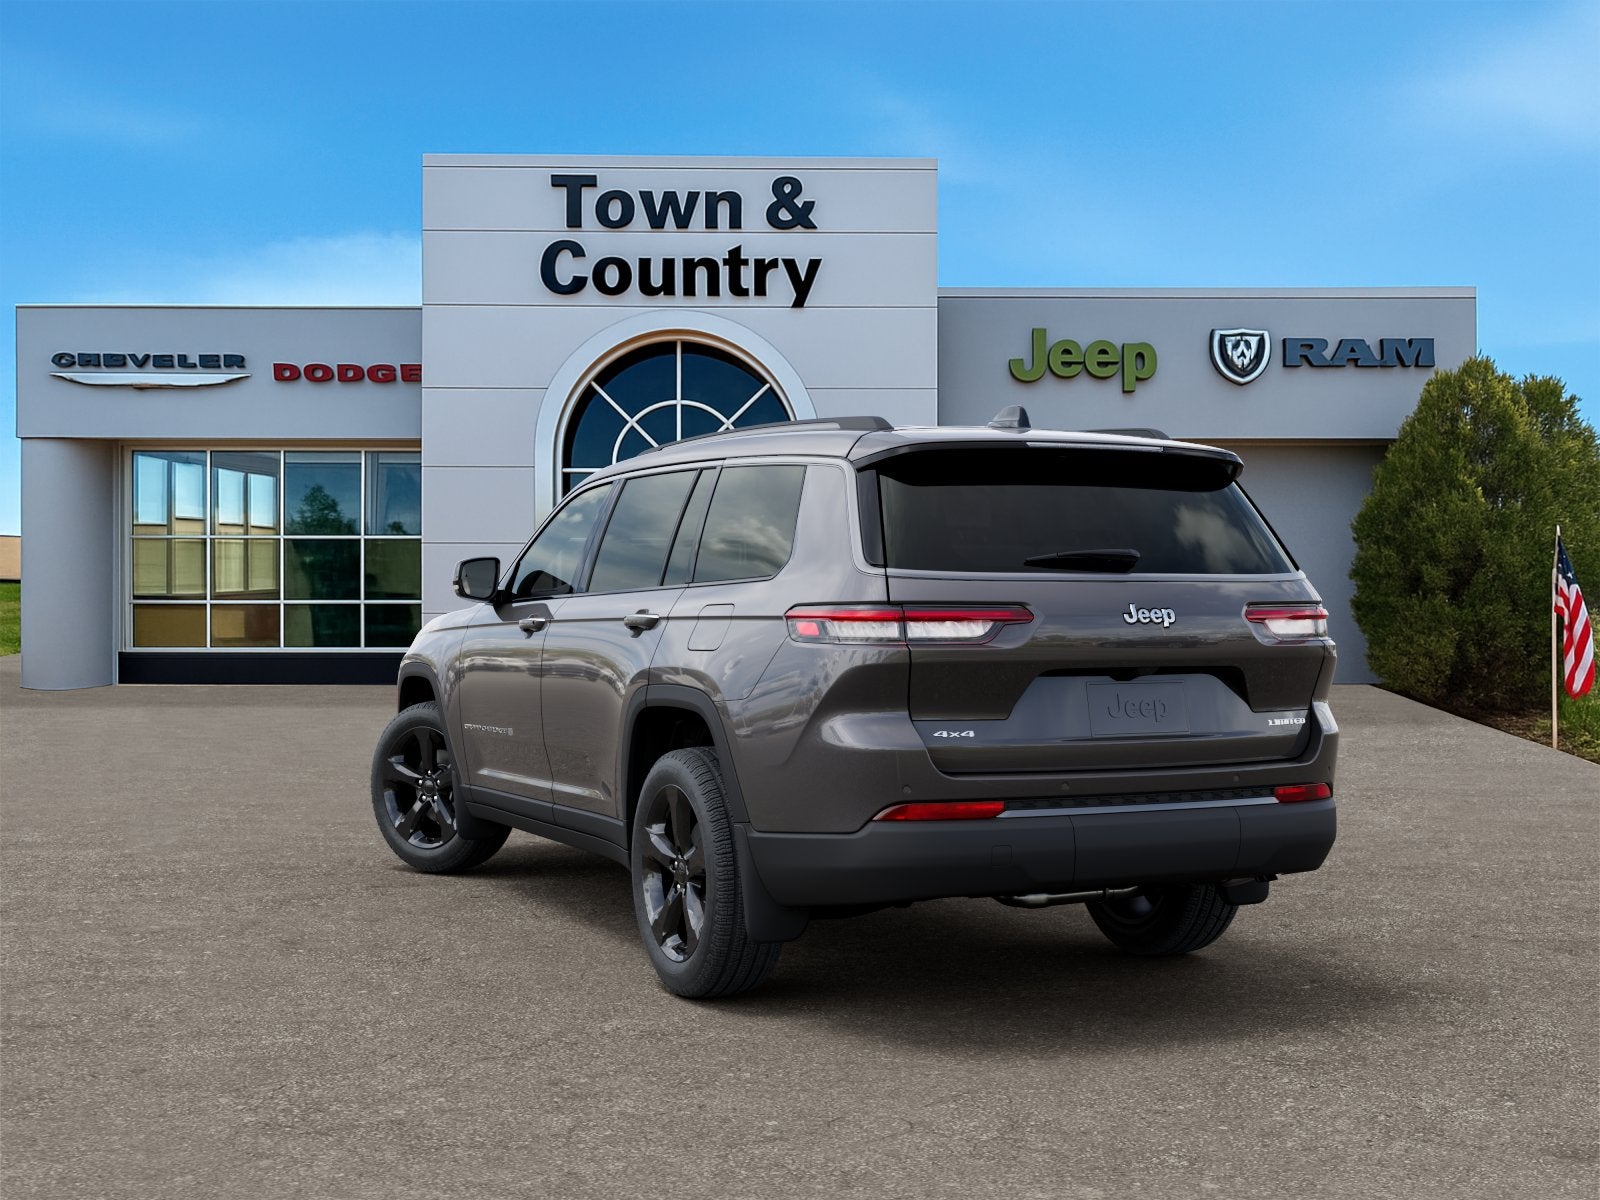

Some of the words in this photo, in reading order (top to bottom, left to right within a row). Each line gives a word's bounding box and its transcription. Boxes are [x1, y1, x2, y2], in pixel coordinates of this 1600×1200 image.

[550, 174, 742, 229] Town
[766, 176, 818, 230] &
[540, 239, 823, 308] Country
[1009, 328, 1158, 393] Jeep
[1283, 337, 1436, 368] RAM
[273, 363, 422, 383] DODGE
[1123, 603, 1176, 628] Jeep
[1107, 692, 1167, 723] Jeep
